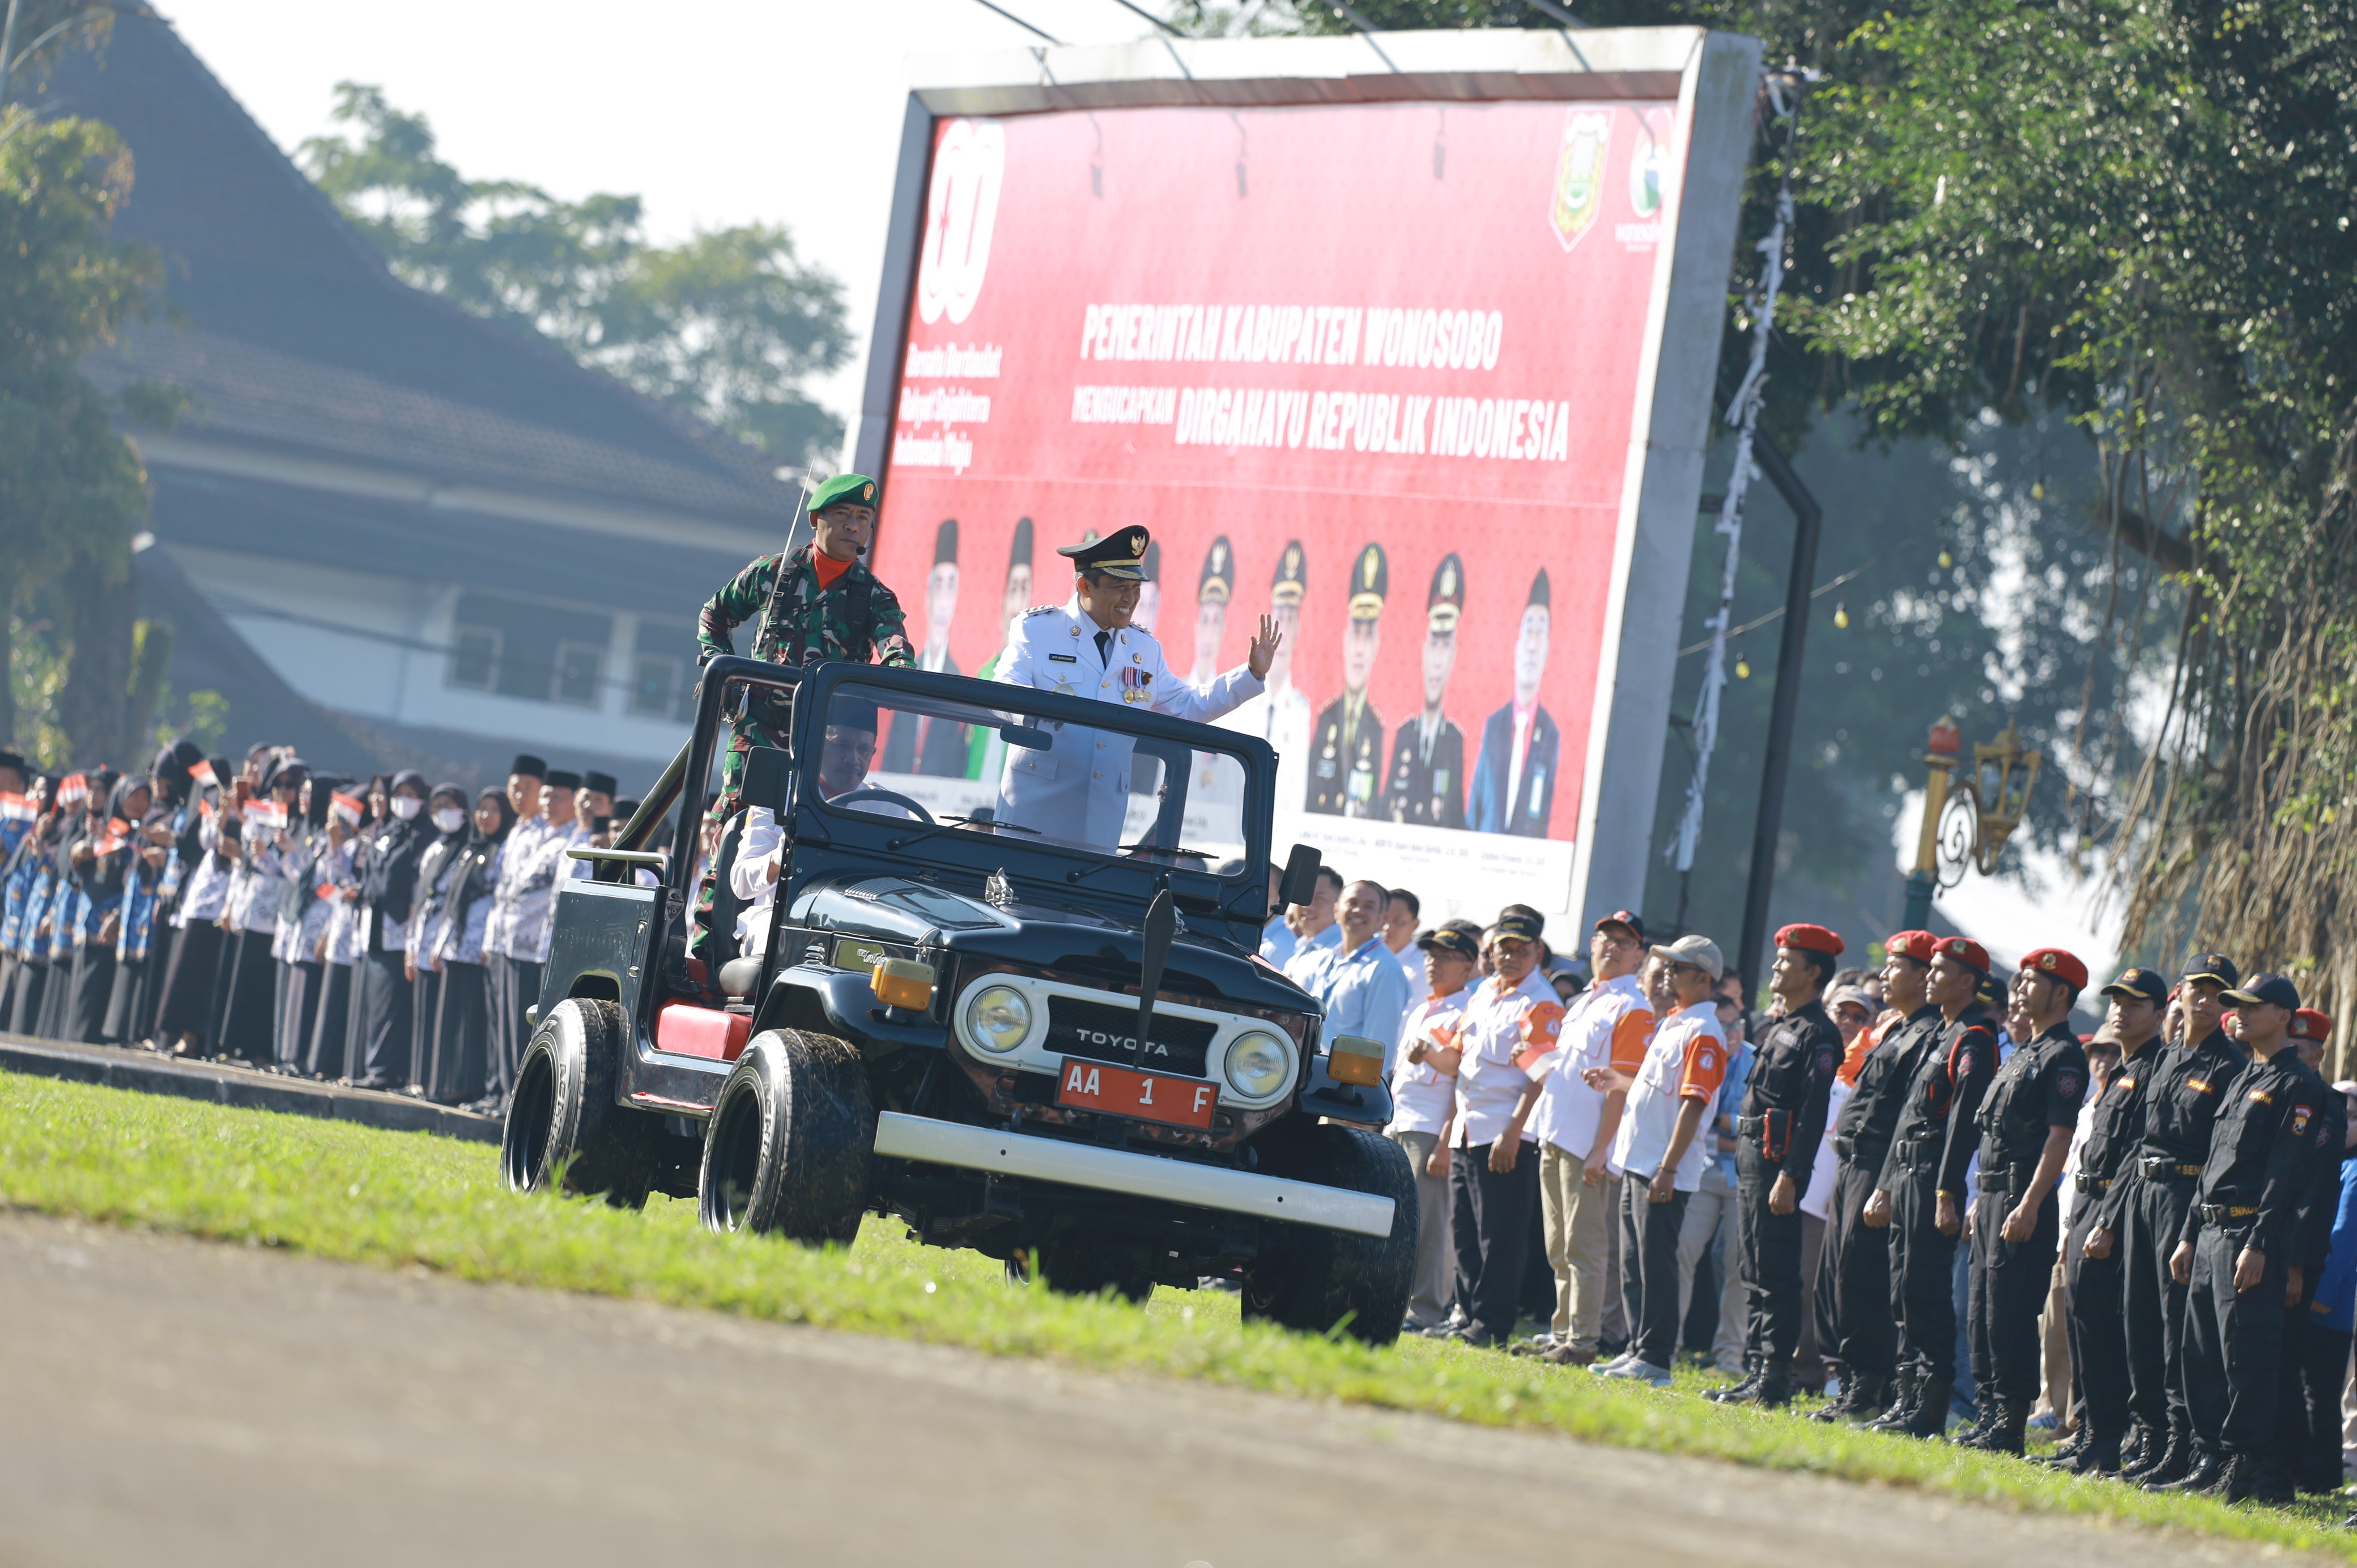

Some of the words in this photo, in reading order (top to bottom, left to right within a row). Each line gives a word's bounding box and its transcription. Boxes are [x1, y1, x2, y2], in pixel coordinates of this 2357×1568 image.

[1080, 304, 1223, 361] PEMERINTAH
[1219, 304, 1363, 365] KABUPATEN
[1363, 306, 1503, 371] WONOSOBO
[1071, 385, 1177, 424] MENGUCAPKAN
[1175, 386, 1309, 449] DIRGAHAYU
[1307, 390, 1432, 455] REPUBLIK
[1430, 395, 1569, 462] INDONESIA
[1077, 1029, 1168, 1056] TOYOTA
[1066, 1066, 1099, 1096] AA
[1139, 1079, 1154, 1105] 1
[1193, 1087, 1210, 1113] F
